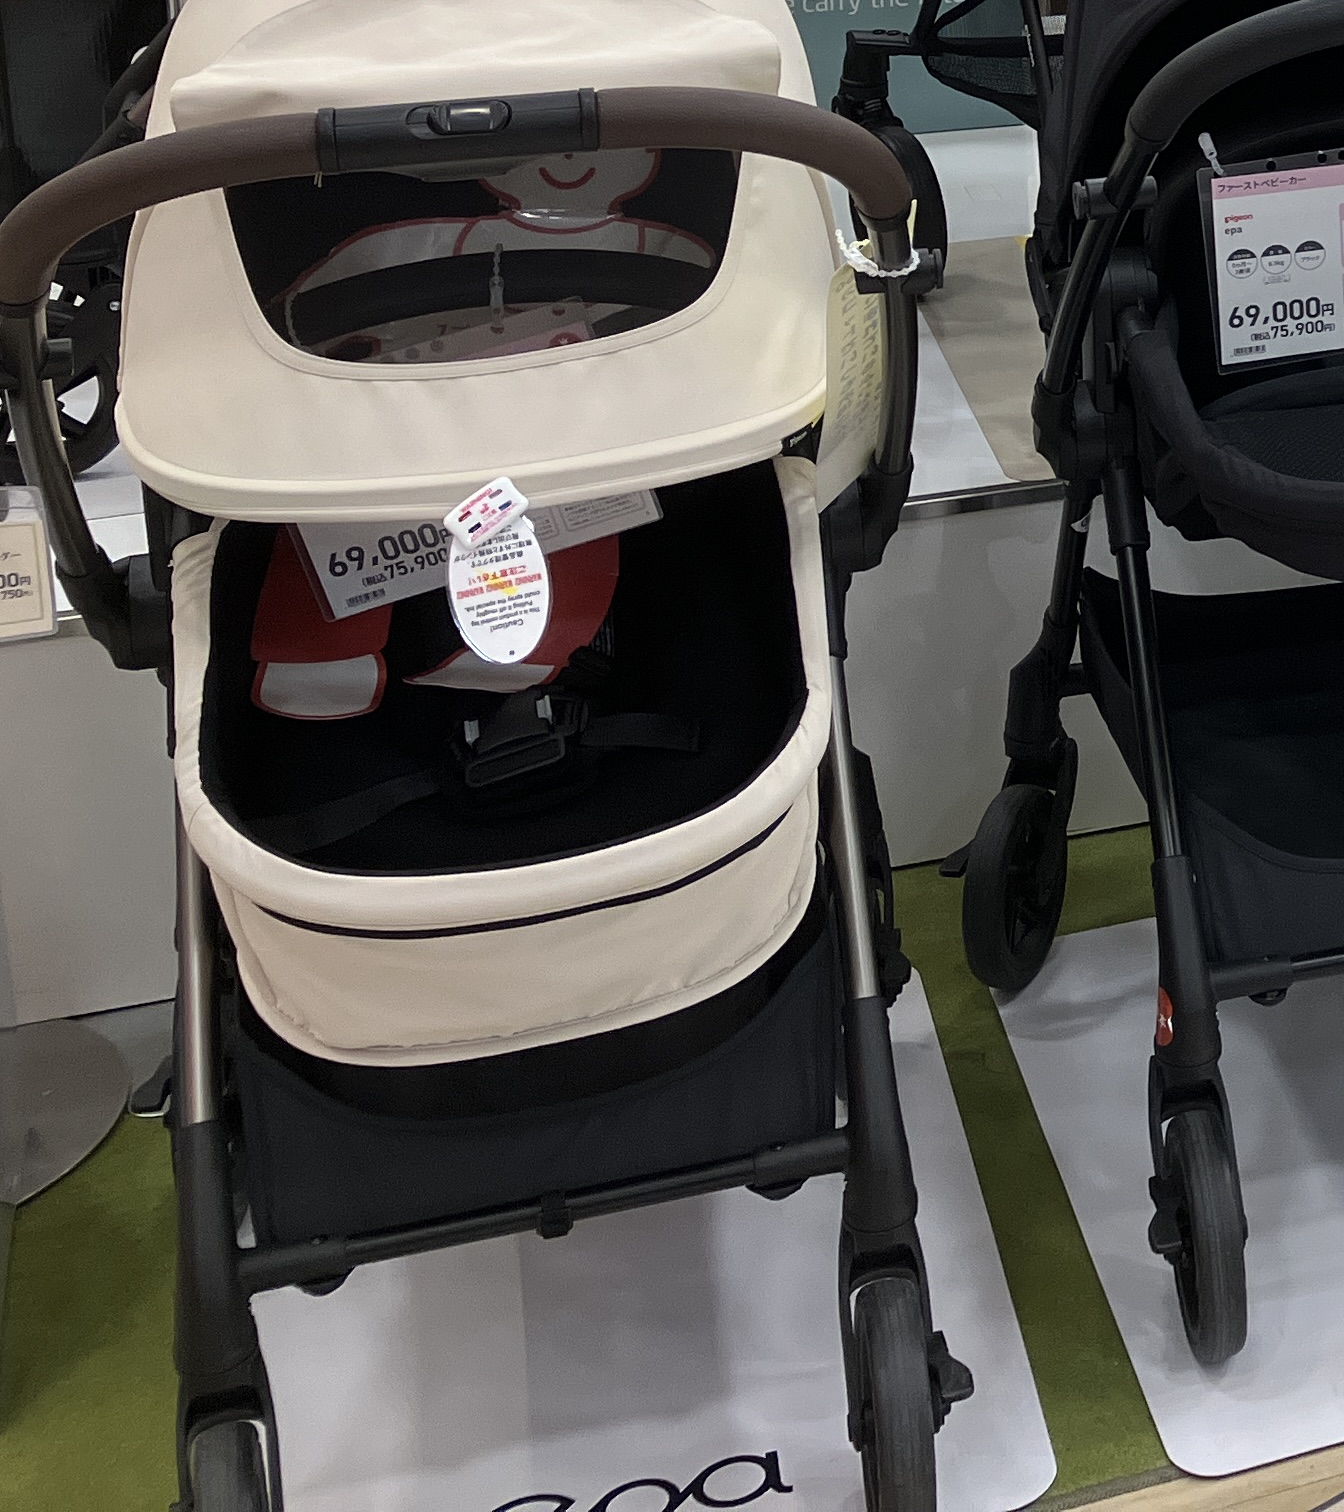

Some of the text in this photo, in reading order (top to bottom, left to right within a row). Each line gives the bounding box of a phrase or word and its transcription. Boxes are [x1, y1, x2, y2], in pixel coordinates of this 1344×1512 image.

[1217, 176, 1307, 193] ファーストベビーカー
[1224, 213, 1253, 223] pigeon
[1224, 226, 1243, 236] epa
[1229, 297, 1335, 329] 69,000円
[468, 565, 526, 585] ご注意下さい!
[490, 618, 524, 633] Caution!
